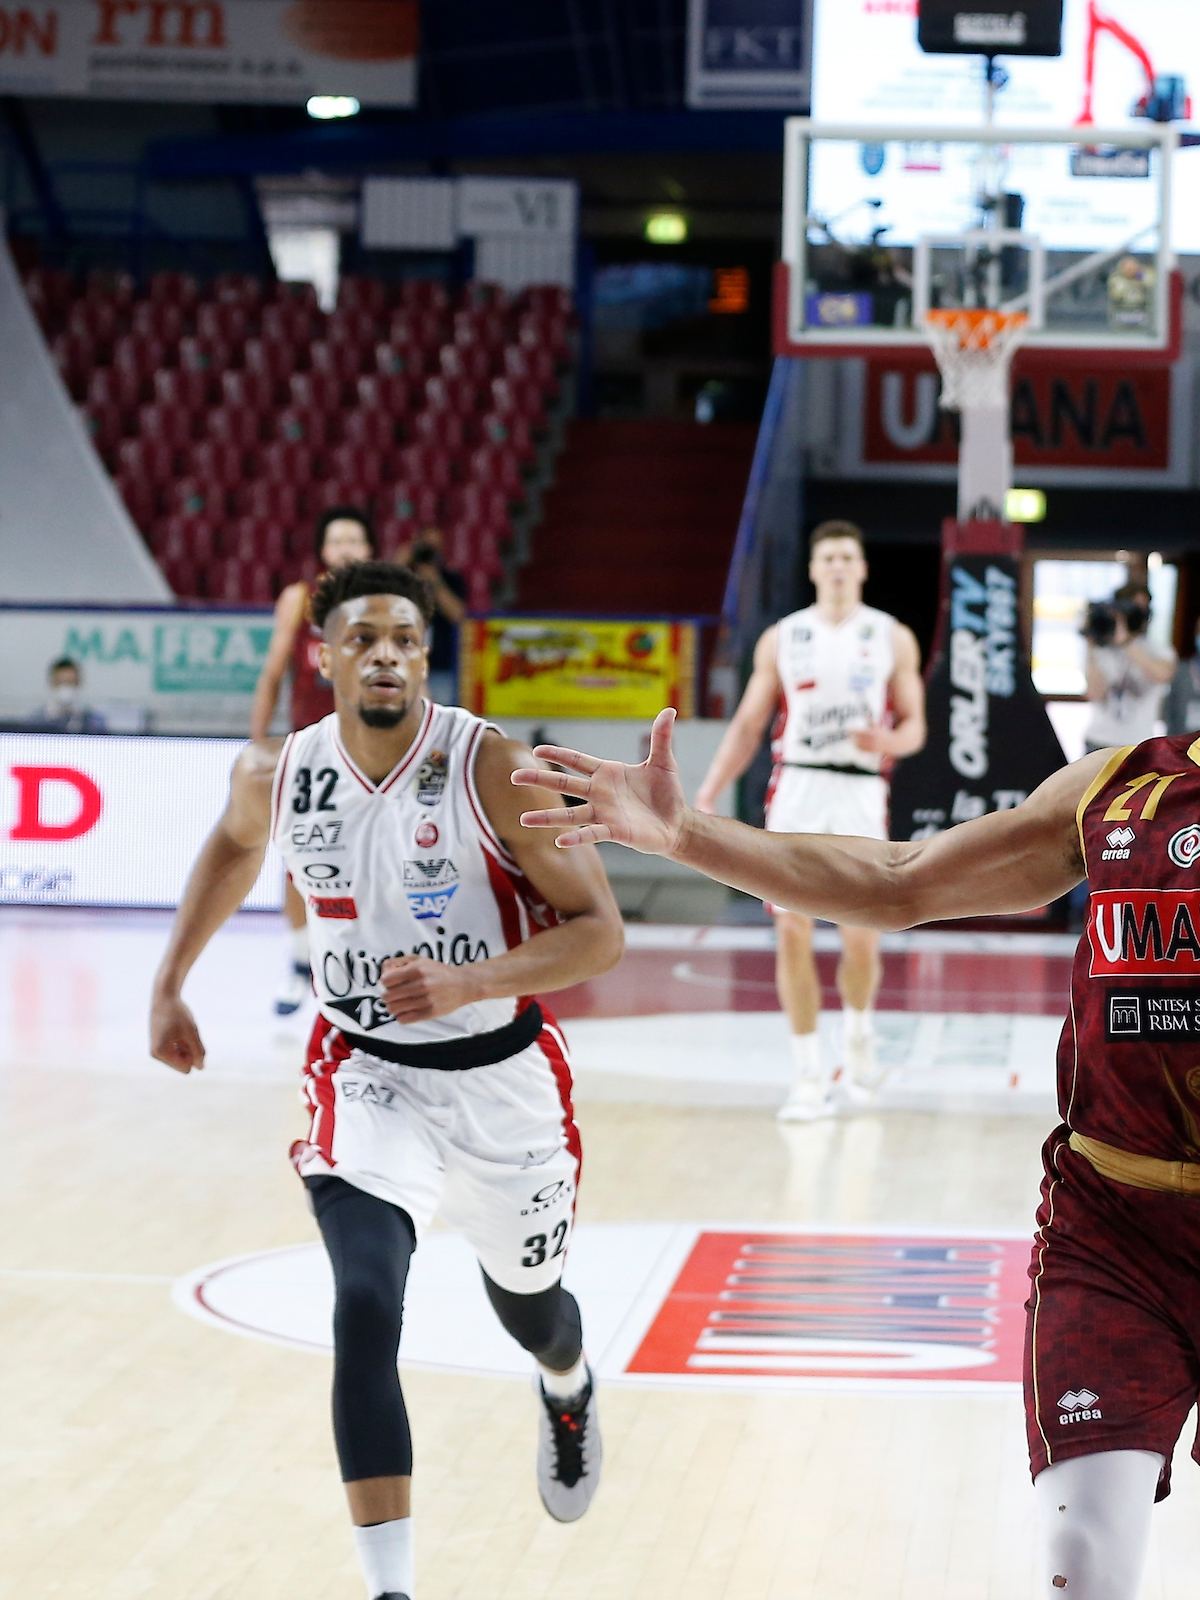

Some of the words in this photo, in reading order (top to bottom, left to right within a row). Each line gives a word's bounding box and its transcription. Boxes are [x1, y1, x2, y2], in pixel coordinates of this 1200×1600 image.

[0, 9, 58, 57] N
[880, 371, 1148, 448] UANA
[10, 765, 105, 841] D
[292, 767, 339, 814] 32
[1102, 771, 1187, 823] 21
[291, 821, 343, 846] EA7
[1101, 848, 1132, 862] errea
[409, 894, 449, 915] SAP
[353, 997, 395, 1030] 19
[1147, 999, 1191, 1012] INTESA
[1149, 1014, 1190, 1031] RBM
[521, 1219, 568, 1268] 32
[1058, 1408, 1102, 1425] errea
